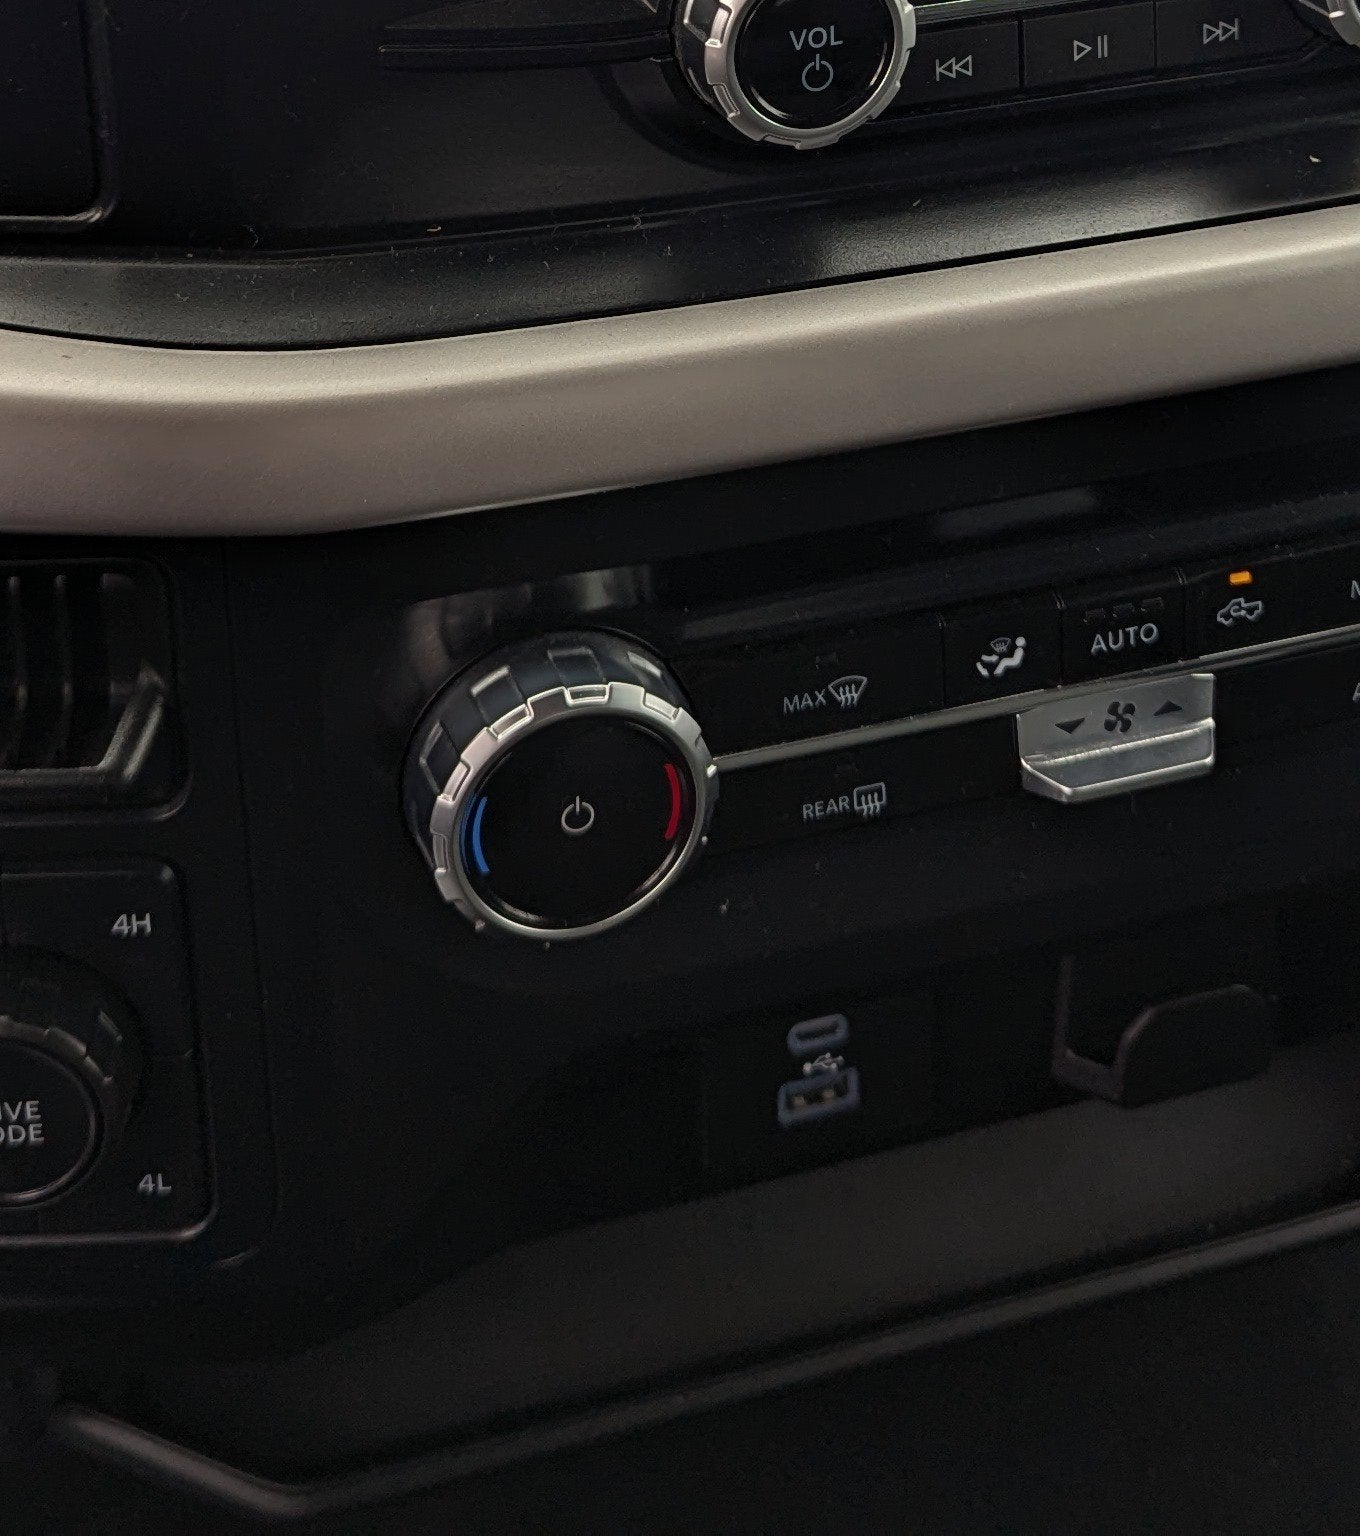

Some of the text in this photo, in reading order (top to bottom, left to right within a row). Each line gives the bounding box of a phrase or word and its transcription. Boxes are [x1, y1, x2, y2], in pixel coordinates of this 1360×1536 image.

[789, 24, 844, 52] VOL
[1090, 622, 1160, 656] AUTO
[782, 687, 829, 714] MAX
[802, 793, 850, 820] REAR
[111, 912, 152, 937] 4H
[138, 1172, 173, 1196] 4L
